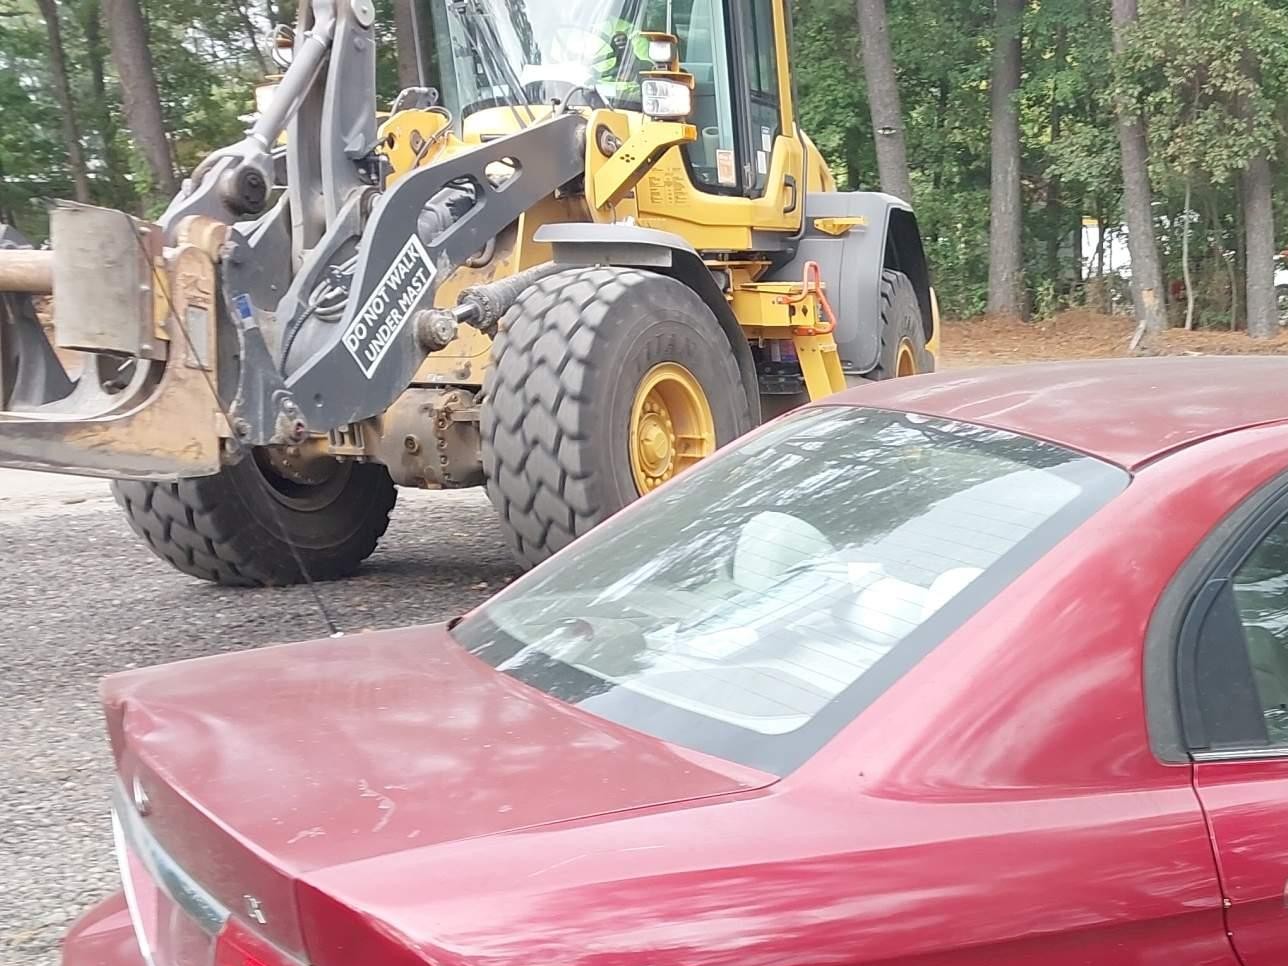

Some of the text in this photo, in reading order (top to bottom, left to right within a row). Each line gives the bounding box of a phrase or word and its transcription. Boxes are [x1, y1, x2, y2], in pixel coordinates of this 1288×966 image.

[349, 243, 421, 350] DO NOT WALK
[364, 267, 427, 362] UNDER MAST
